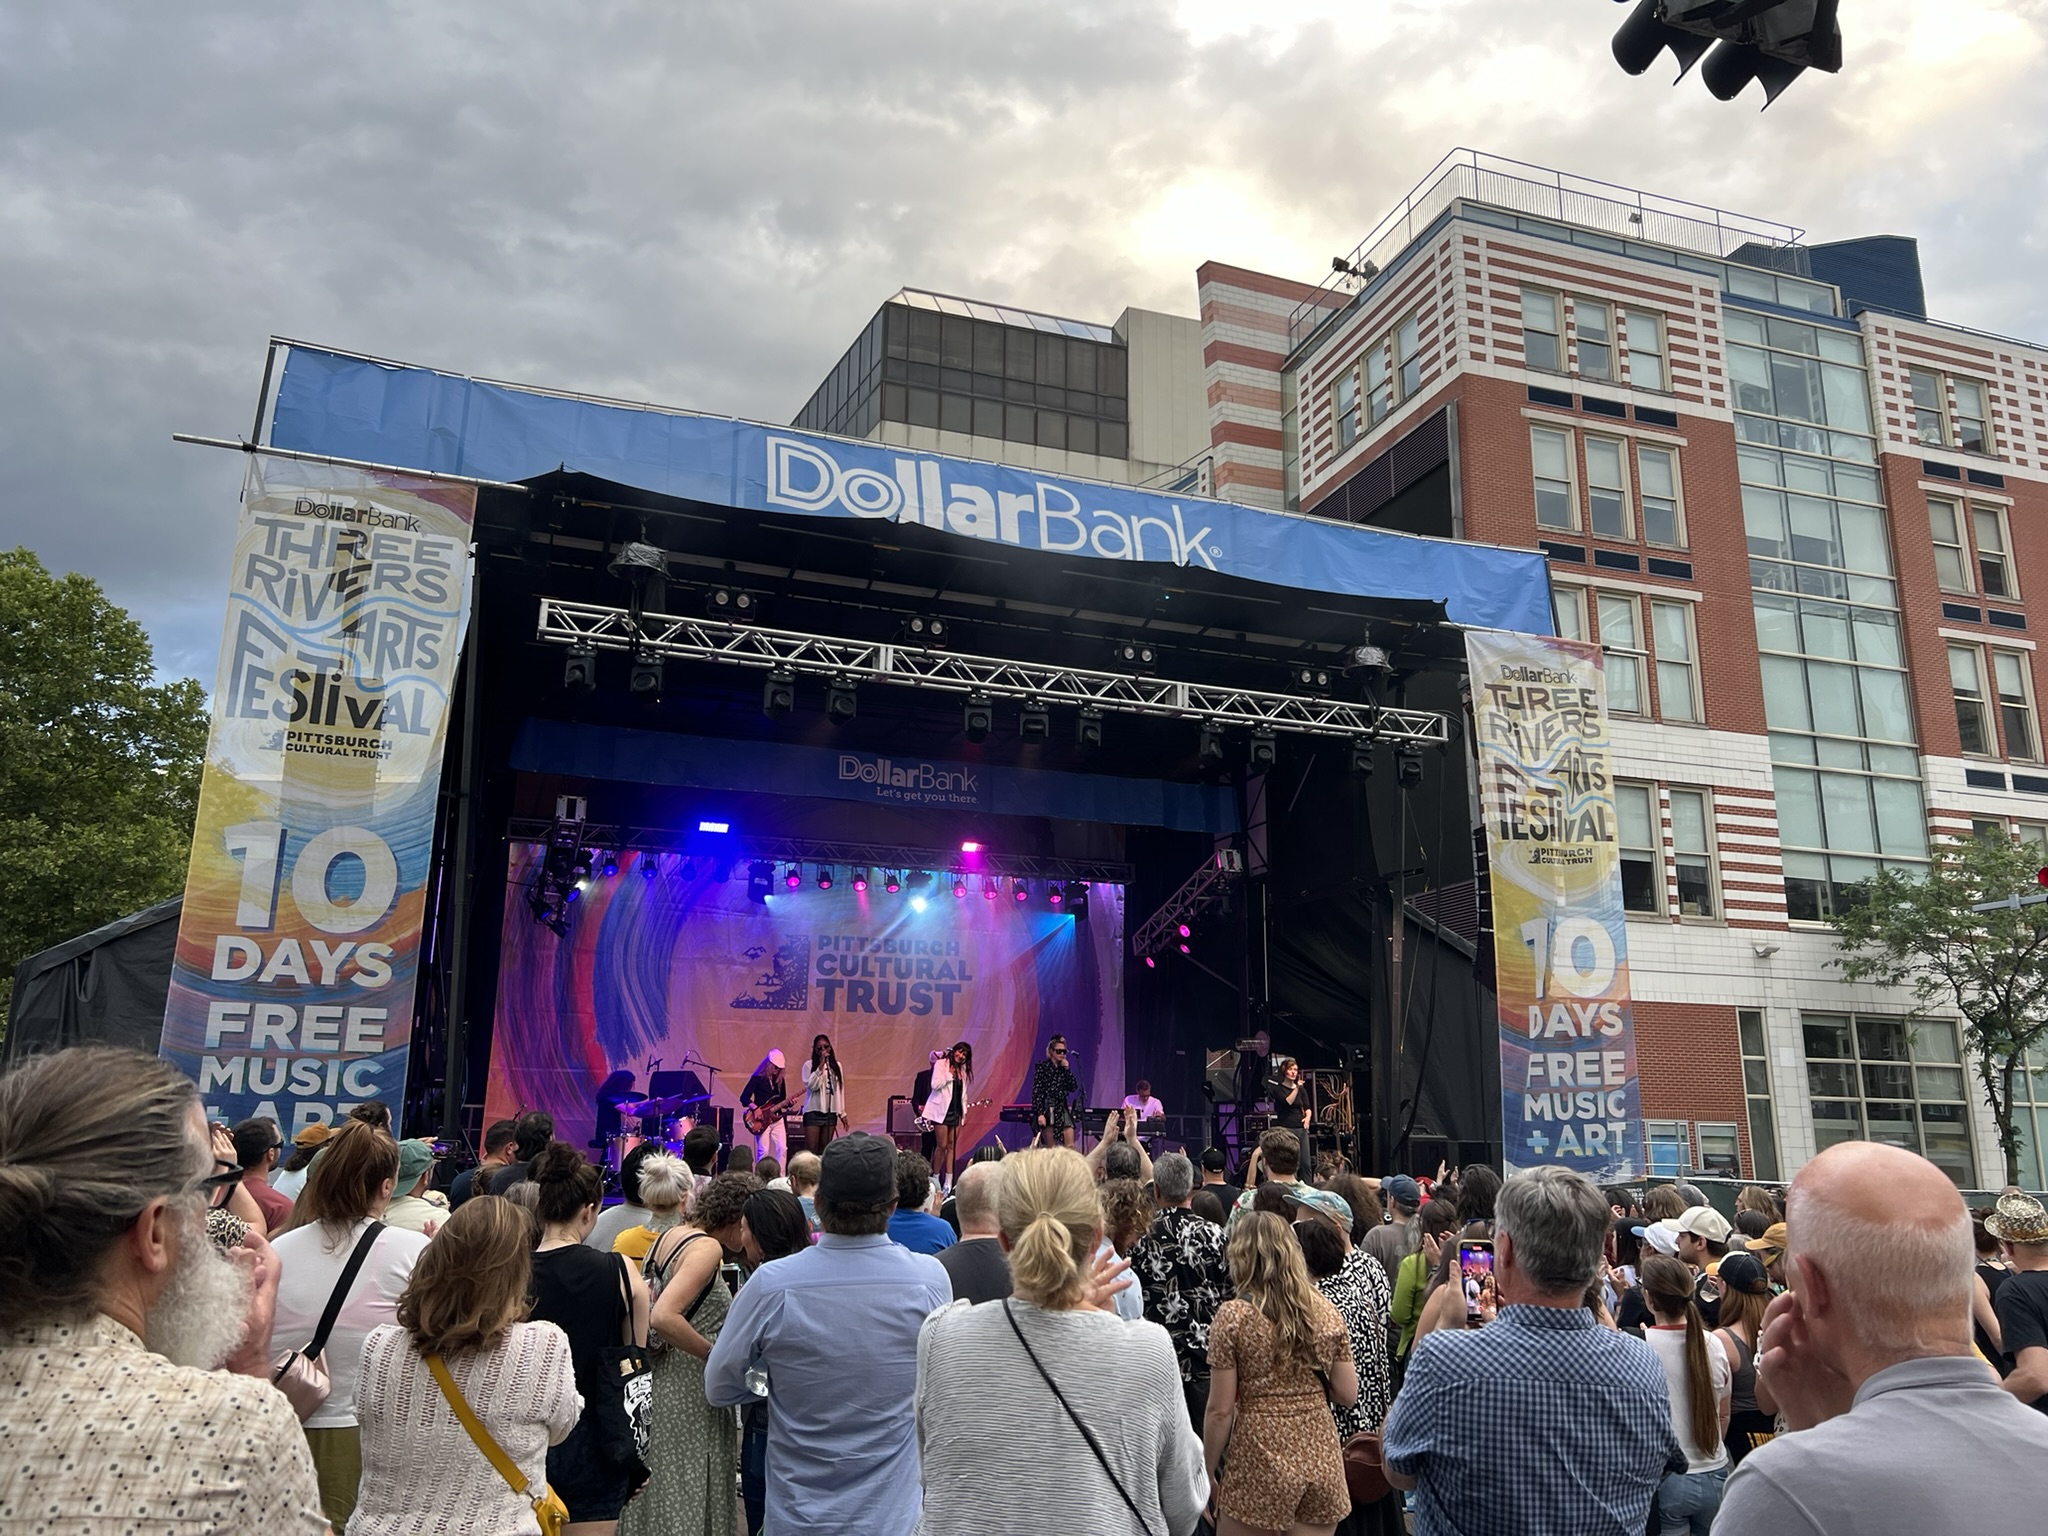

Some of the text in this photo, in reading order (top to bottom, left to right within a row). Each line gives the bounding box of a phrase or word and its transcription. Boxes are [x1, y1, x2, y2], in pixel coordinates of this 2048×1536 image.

[294, 497, 421, 533] DollarBank
[767, 436, 1218, 571] DollarBank
[254, 516, 454, 570] THREE
[328, 608, 443, 679] ARTS
[1500, 664, 1577, 684] DollarBank
[1484, 683, 1599, 721] THREE
[285, 743, 392, 761] CULTURAL TRUST
[287, 731, 393, 750] PITTSBURGH
[838, 755, 978, 793] DollarBank
[1549, 747, 1607, 804] ARTS
[876, 786, 902, 799] Let's
[903, 791, 922, 802] get
[924, 793, 947, 803] you
[223, 820, 400, 936] 10
[1566, 857, 1593, 865] TRUST
[210, 935, 395, 989] DAYS
[818, 935, 961, 958] PITTSBURGH
[1519, 915, 1616, 999] 10
[815, 953, 973, 982] CULTURAL
[815, 978, 963, 1016] TRUST
[203, 1001, 389, 1053] FREE
[1528, 1002, 1624, 1040] DAYS
[199, 1055, 385, 1098] MUSIC
[1526, 1051, 1627, 1088] FREE
[1523, 1090, 1627, 1122] MUSIC
[1554, 1121, 1628, 1158] ART
